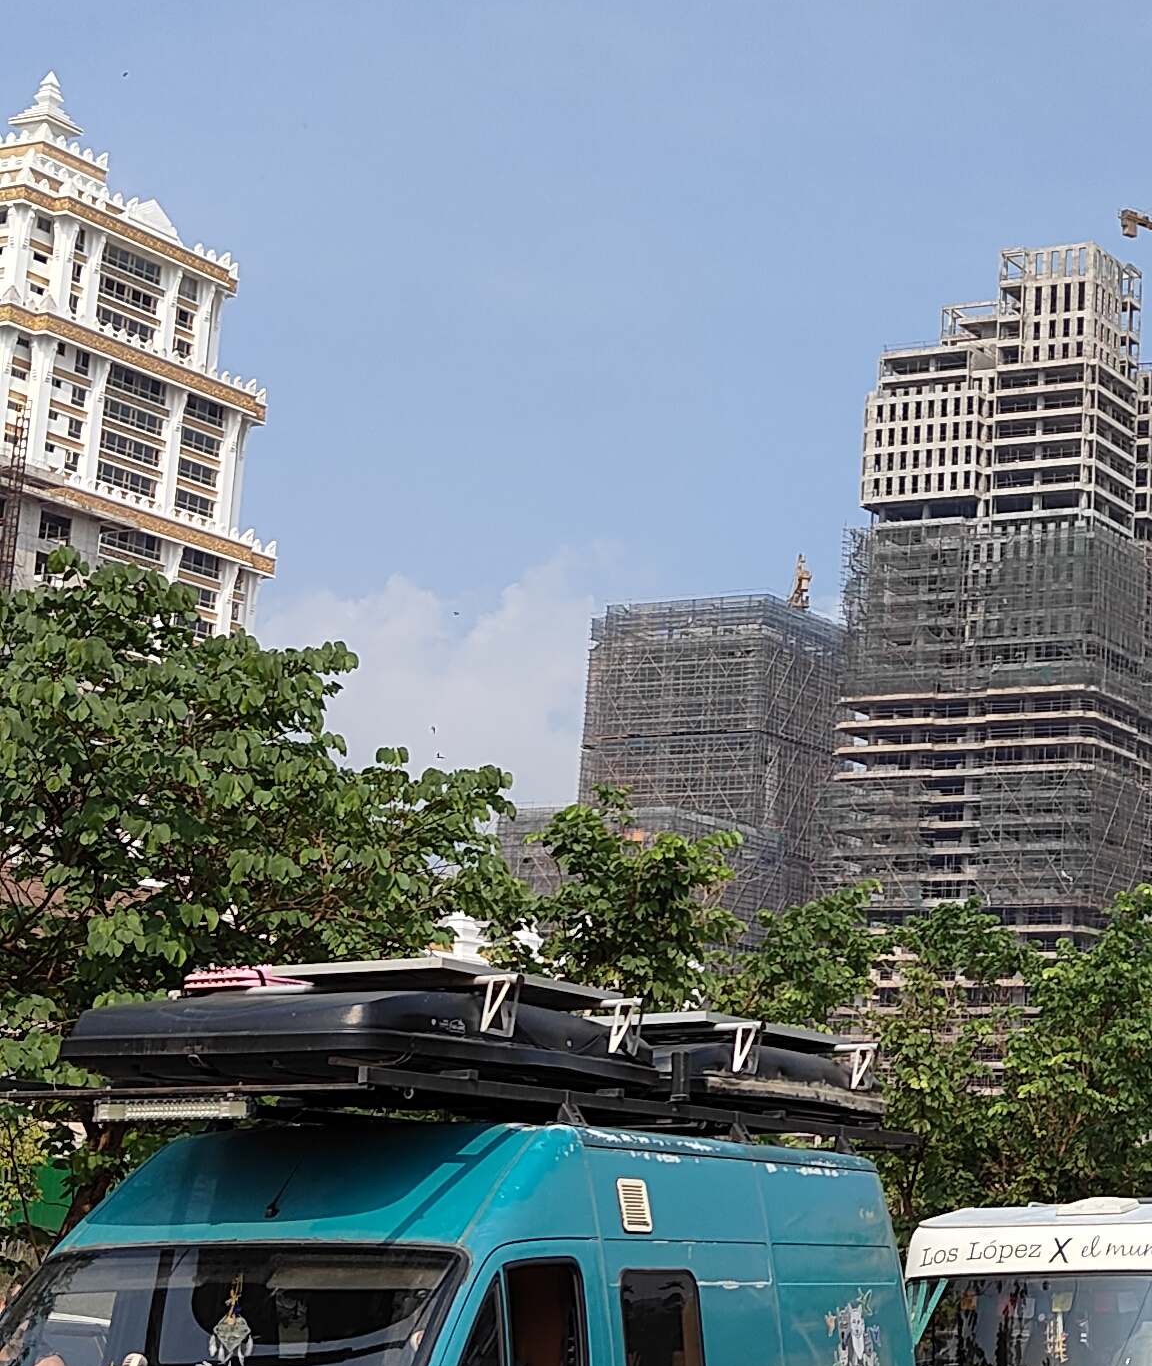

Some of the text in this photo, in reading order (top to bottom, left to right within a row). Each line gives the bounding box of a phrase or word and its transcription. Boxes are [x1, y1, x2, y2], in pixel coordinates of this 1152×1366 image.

[919, 1246, 959, 1268] Los
[966, 1239, 1042, 1264] López
[1048, 1237, 1073, 1264] X
[1080, 1235, 1101, 1259] el
